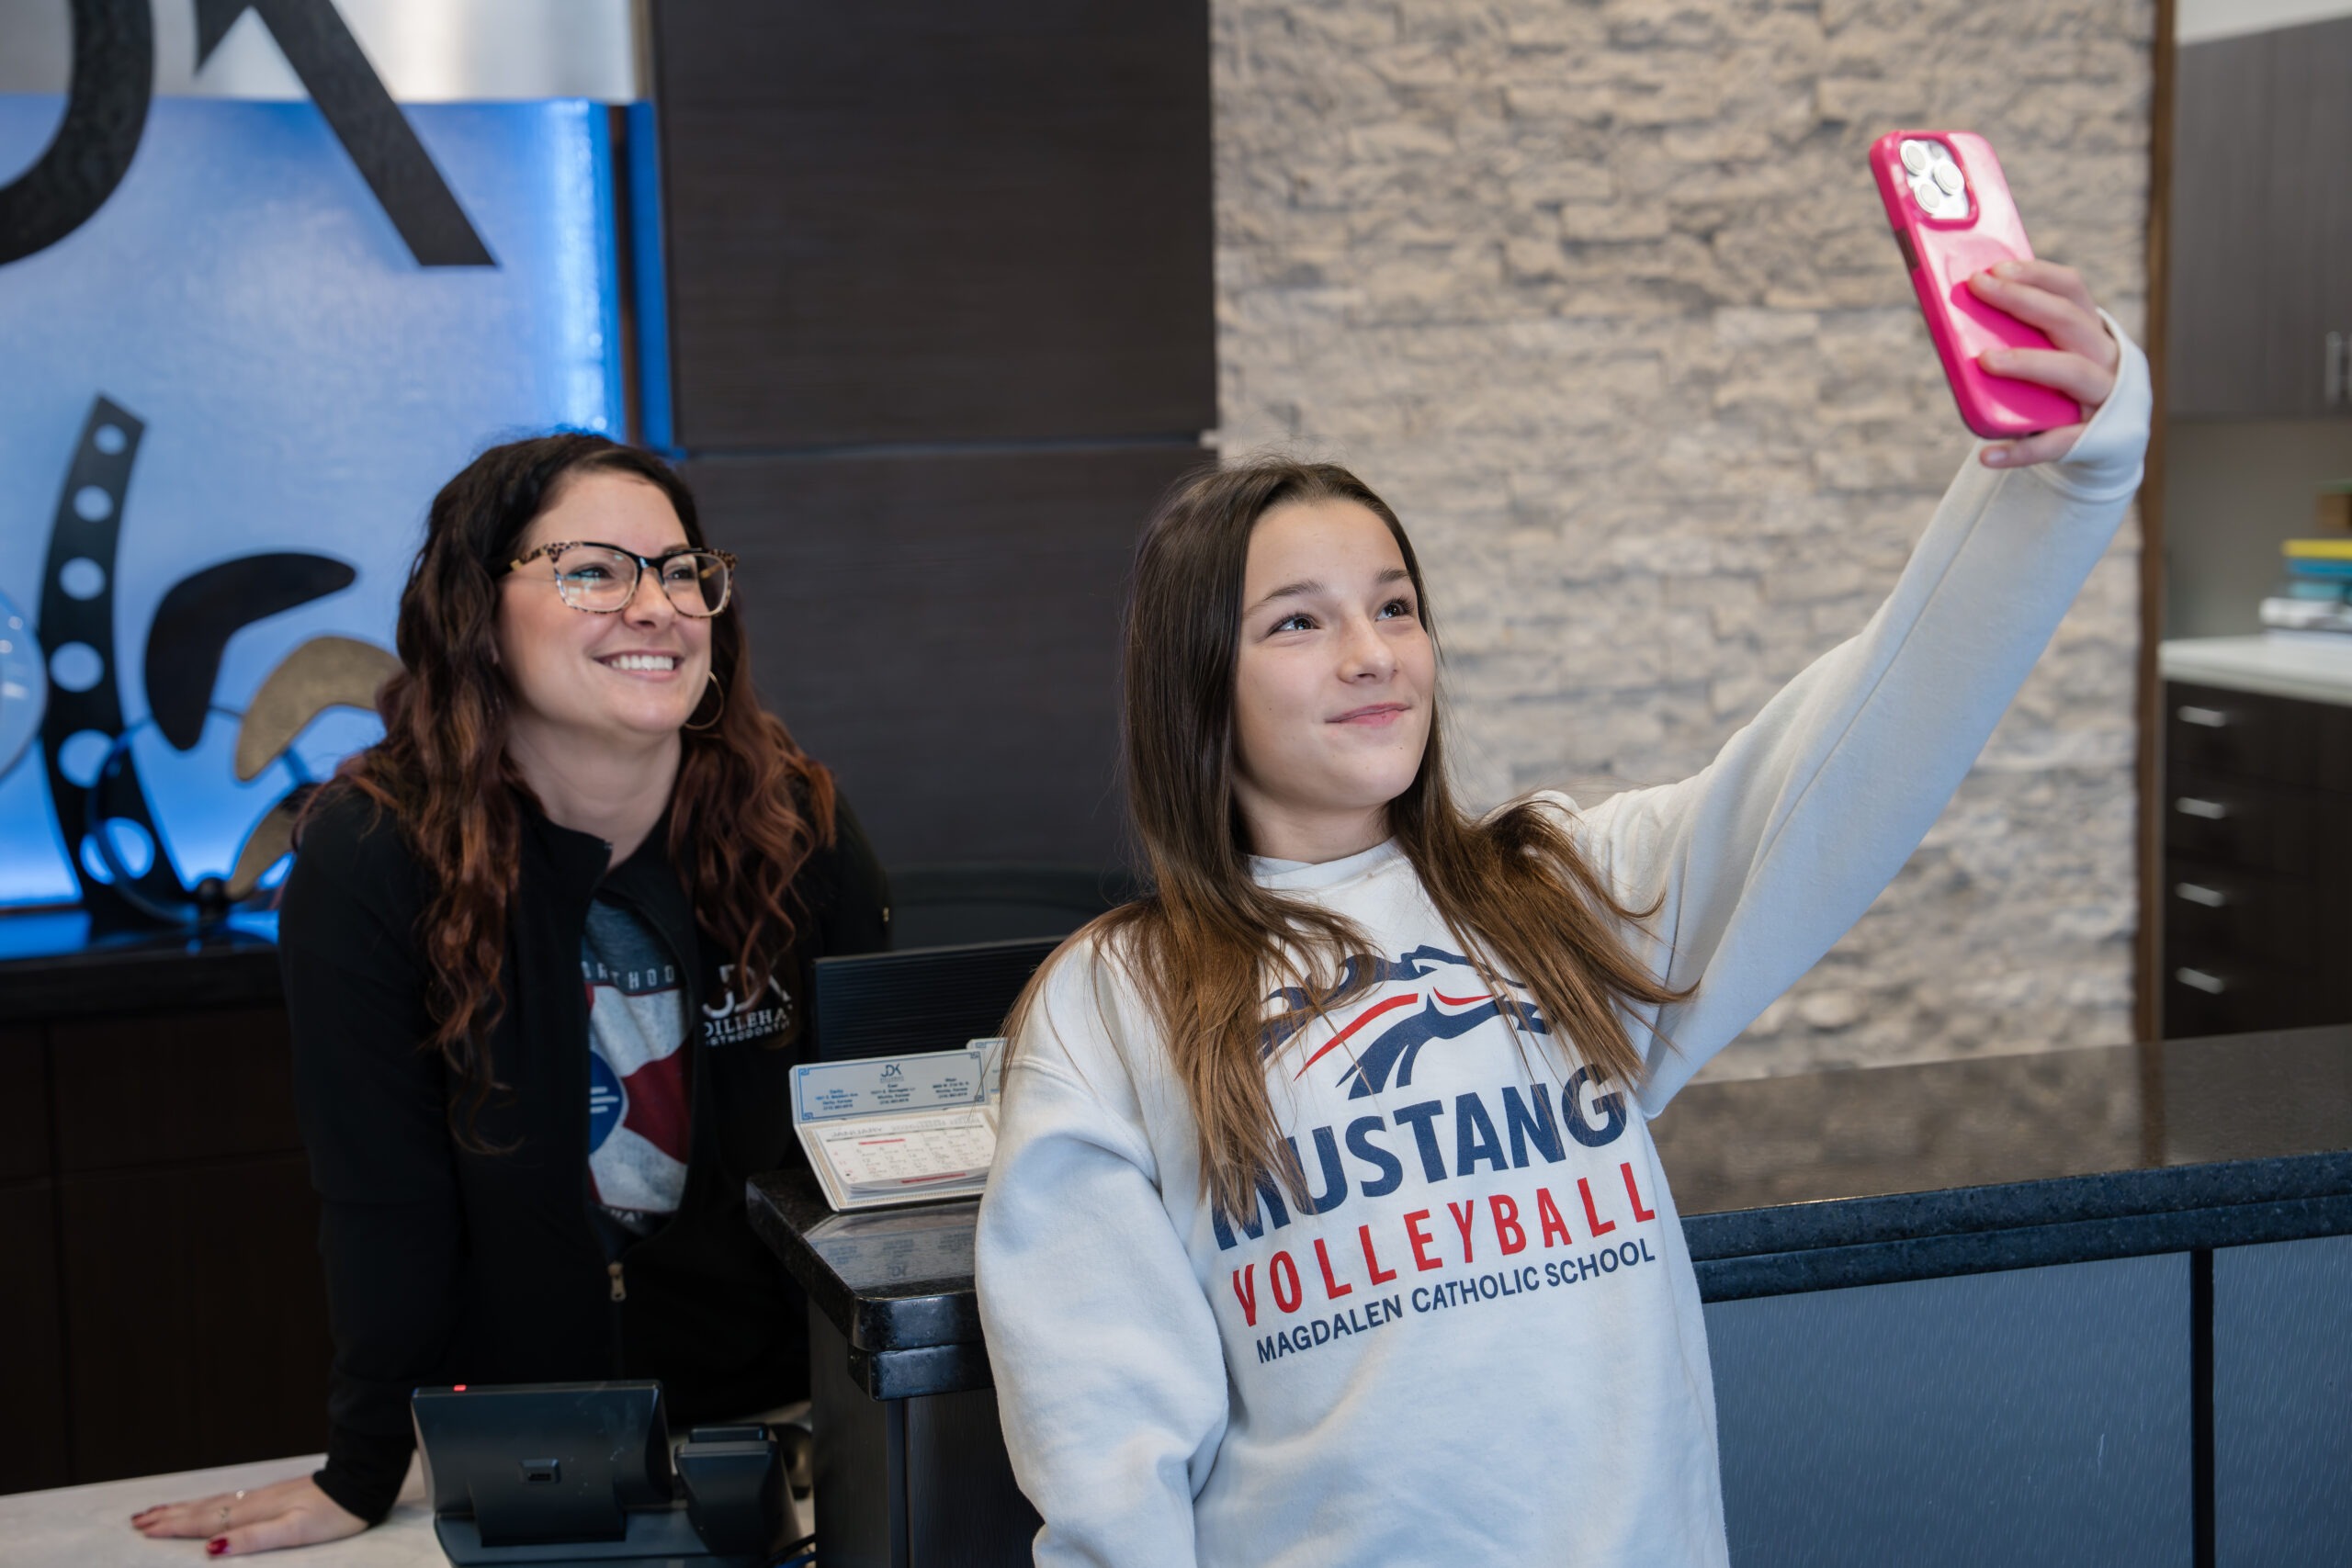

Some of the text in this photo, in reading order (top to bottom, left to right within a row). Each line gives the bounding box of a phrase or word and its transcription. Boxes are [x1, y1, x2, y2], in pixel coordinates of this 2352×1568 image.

[880, 1063, 901, 1077] JDK
[1233, 1162, 1656, 1326] VOLLEYBALL
[1256, 1237, 1657, 1364] MAGDALEN CATHOLIC SCHOOL
